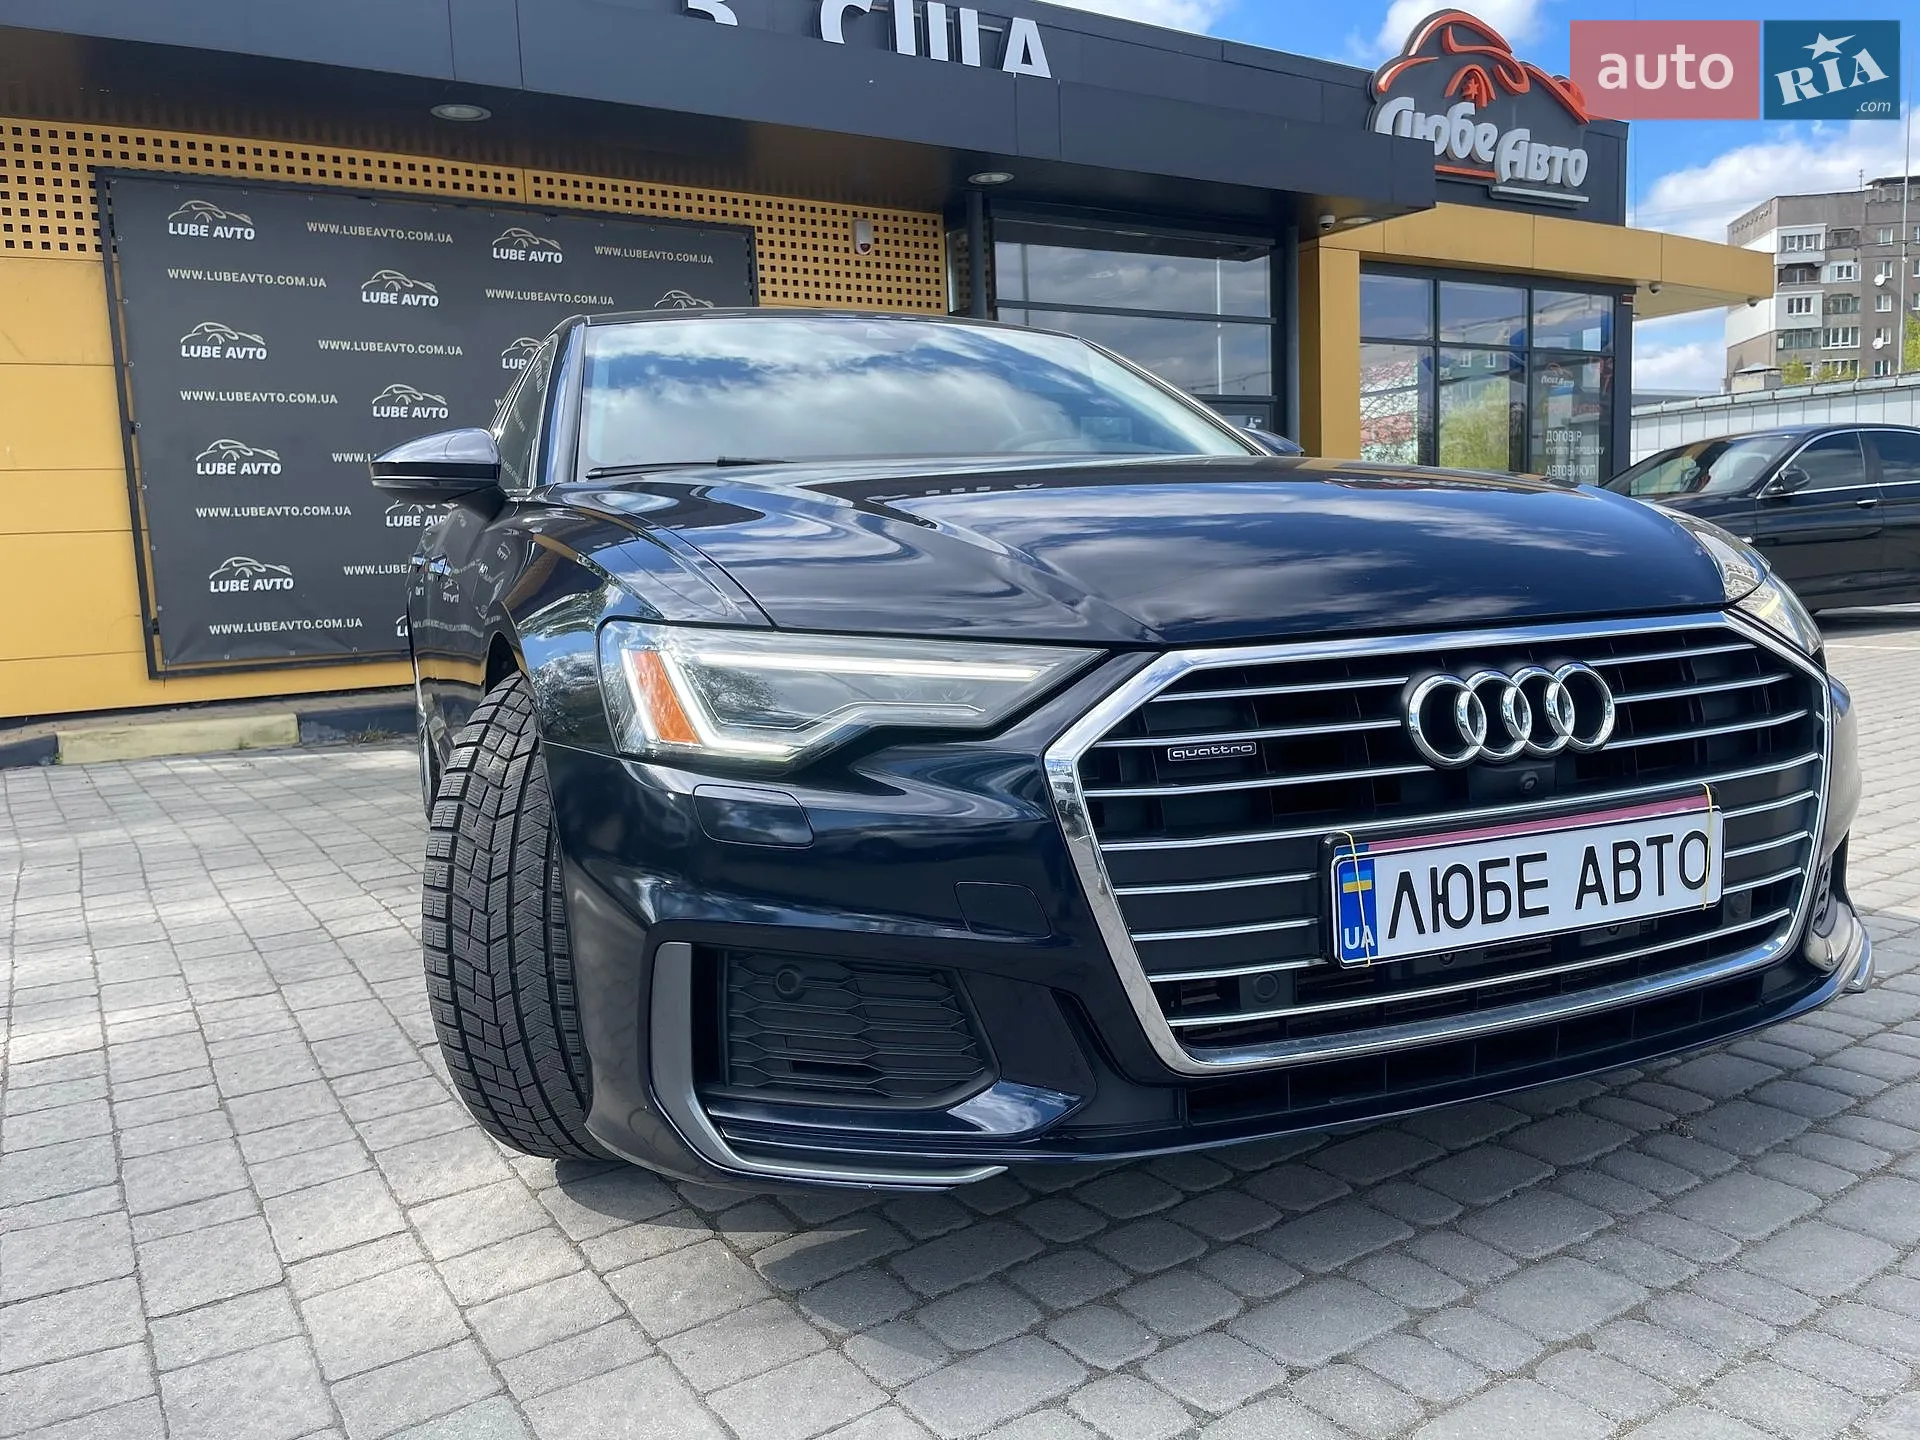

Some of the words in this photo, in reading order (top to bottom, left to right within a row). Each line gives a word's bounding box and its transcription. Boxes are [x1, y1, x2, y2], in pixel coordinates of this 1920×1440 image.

[169, 222, 209, 237] LUBE
[213, 225, 255, 240] AVTO
[307, 221, 453, 244] WWW.LUBEAVTO.COM.UA
[492, 247, 526, 262] LUBE
[529, 250, 563, 264] AVTO
[595, 246, 714, 264] WWW.LUBEAVTO.COM.UA
[167, 268, 327, 288] WWW.LUBEAVTO.COM.UA
[361, 291, 398, 305] LUBE
[401, 293, 439, 307] AVTO
[485, 289, 615, 306] WWW.LUBEAVTO.COM.UA
[181, 345, 221, 359] LUBE
[225, 346, 267, 360] AVTO
[318, 340, 463, 356] WWW.LUBEAVTO.COM.UA
[180, 390, 338, 404] WWW.LUBEAVTO.COM.UA
[372, 405, 408, 418] LUBE
[411, 406, 449, 419] AVTO
[196, 462, 236, 475] LUBE
[240, 461, 282, 475] AVTO
[196, 505, 351, 518] WWW.LUBEAVTO.COM.UA
[386, 515, 421, 527] LUBE
[210, 578, 249, 592] LUBE
[253, 578, 294, 591] AVTO
[209, 617, 363, 635] WWW.LUBEAVTO.COM.UA
[1172, 744, 1252, 759] quattro
[1388, 852, 1549, 939] ЛЮБЕ
[1575, 830, 1711, 910] АВТО
[1344, 925, 1375, 950] UA
